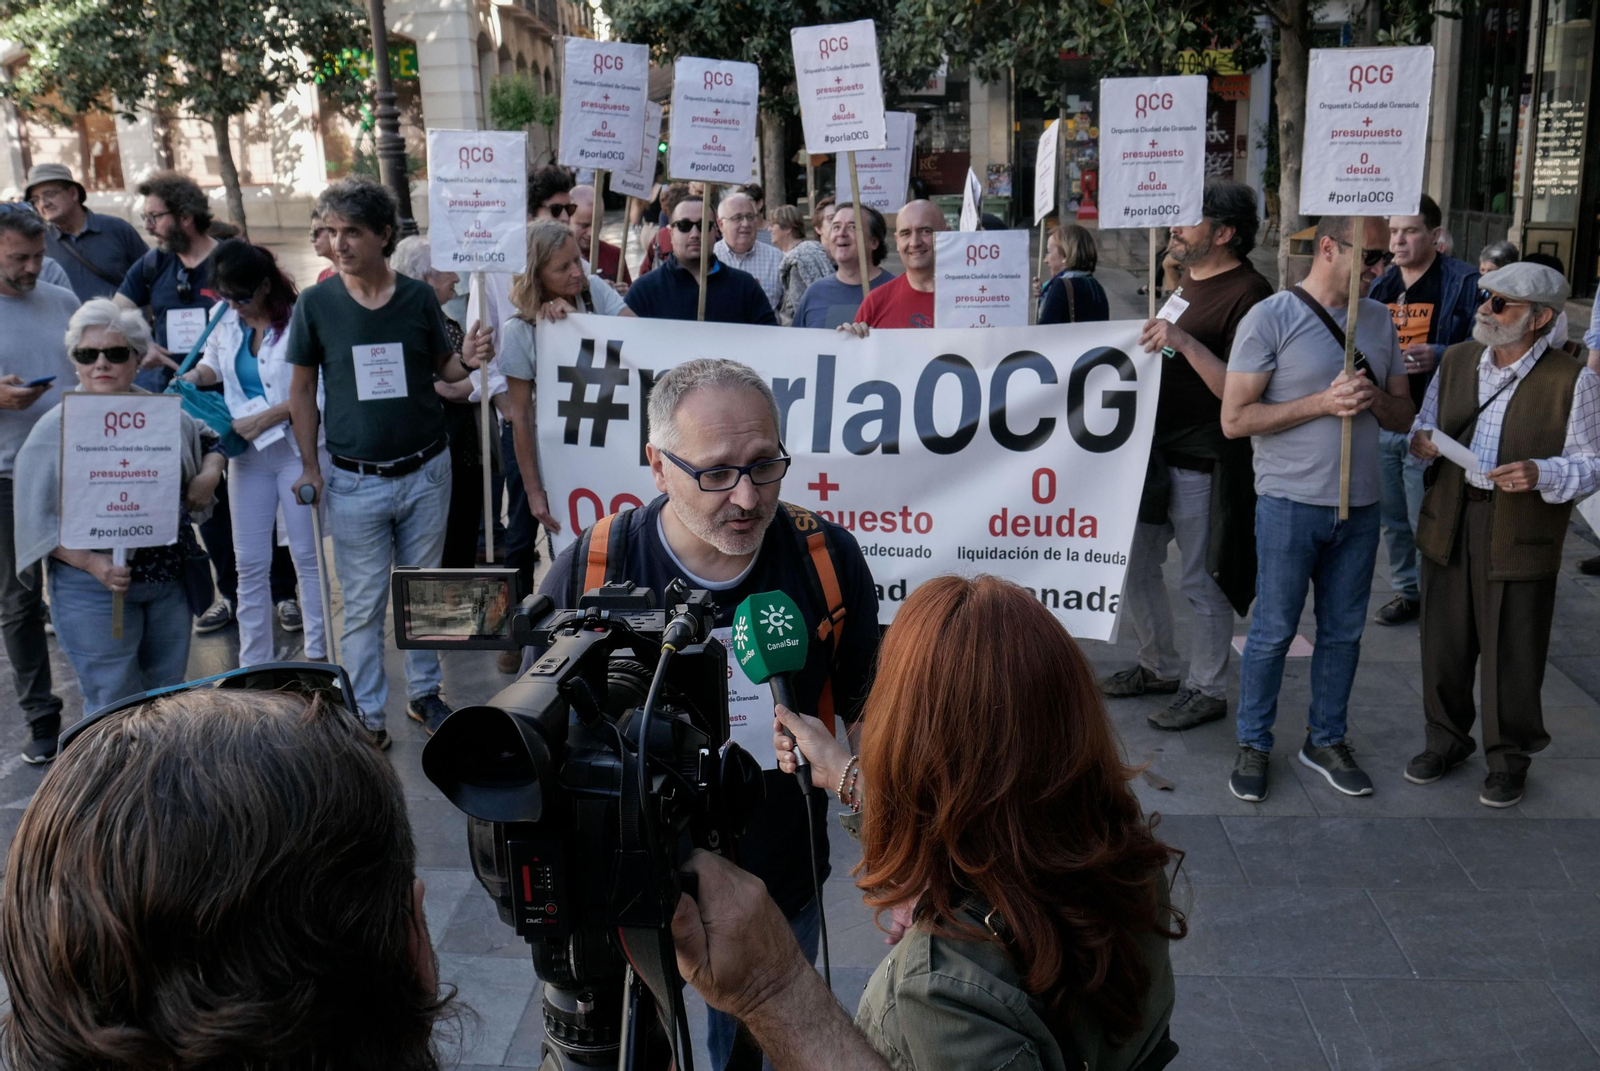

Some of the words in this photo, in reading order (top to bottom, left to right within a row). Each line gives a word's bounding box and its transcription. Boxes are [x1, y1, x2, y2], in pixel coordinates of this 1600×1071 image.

[816, 82, 864, 96] presupuesto
[580, 101, 630, 112] presupuesto
[1319, 102, 1352, 110] Orquesta
[692, 115, 740, 126] presupuesto
[832, 112, 855, 121] deuda
[592, 129, 616, 138] deuda
[1111, 127, 1139, 135] Orquesta
[1331, 128, 1402, 139] presupuesto
[824, 131, 869, 144] #porlaOCG
[702, 143, 726, 152] deuda
[579, 149, 625, 160] #porlaOCG
[1122, 149, 1184, 160] presupuesto
[690, 162, 735, 173] #porlaOCG
[1346, 165, 1380, 174] deuda
[1138, 182, 1167, 191] deuda
[1328, 192, 1394, 204] #porlaOCG
[449, 200, 506, 208] presupuesto
[1123, 205, 1180, 218] #porlaOCG
[464, 230, 492, 238] deuda
[452, 252, 506, 263] #porlaOCG
[955, 295, 1010, 304] presupuesto
[90, 469, 158, 480] presupuesto
[106, 502, 140, 512] deuda
[988, 508, 1098, 538] deuda
[89, 526, 153, 538] #porlaOCG
[861, 543, 932, 558] adecuado
[957, 546, 1039, 562] liquidación
[1043, 547, 1061, 560] de
[1066, 548, 1079, 562] la
[1084, 549, 1126, 566] deuda
